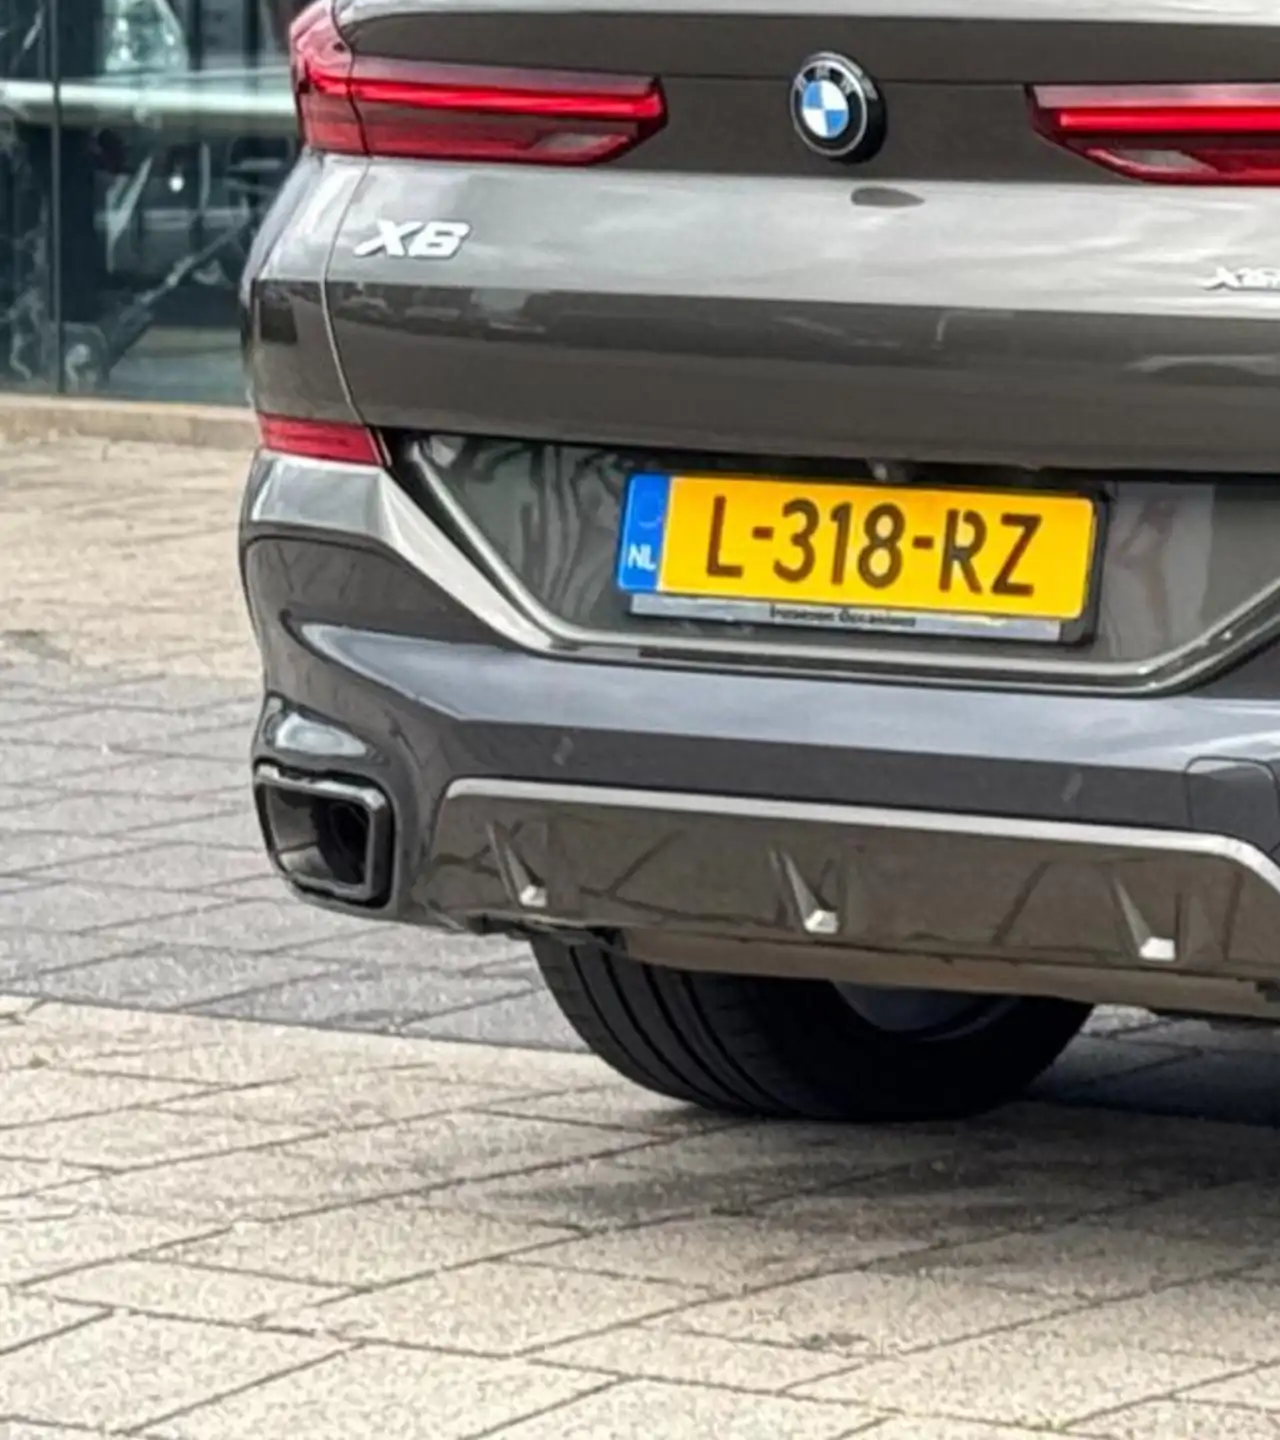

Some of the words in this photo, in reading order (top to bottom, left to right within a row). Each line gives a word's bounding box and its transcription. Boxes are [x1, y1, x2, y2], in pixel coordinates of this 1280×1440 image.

[353, 219, 472, 258] X6
[627, 543, 657, 571] NL
[705, 494, 1043, 598] L-318-RZ
